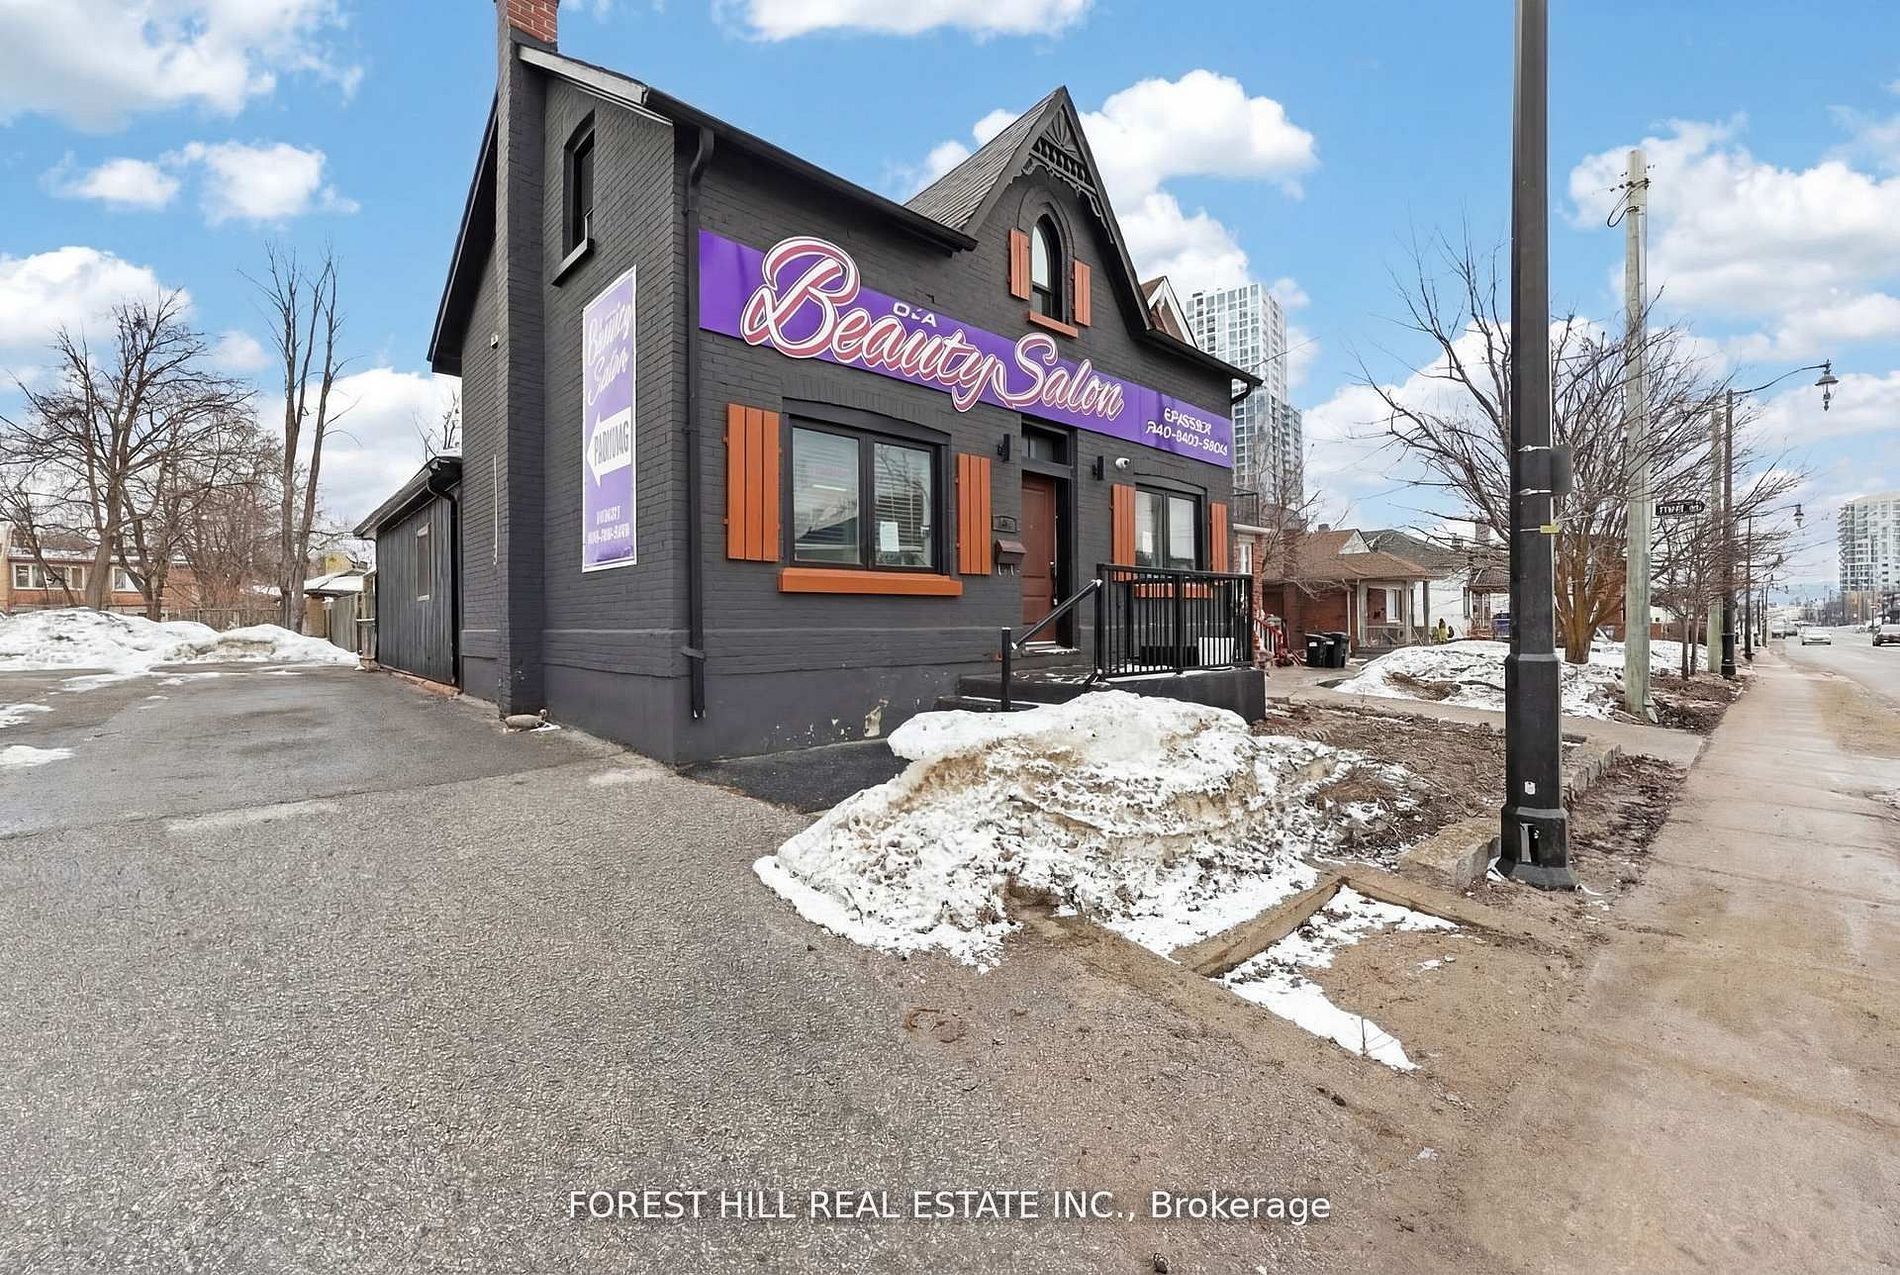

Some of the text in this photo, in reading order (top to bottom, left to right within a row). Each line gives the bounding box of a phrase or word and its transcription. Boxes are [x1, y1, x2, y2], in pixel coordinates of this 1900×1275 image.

[587, 347, 629, 406] Salon
[739, 235, 1125, 422] Beauty Salon
